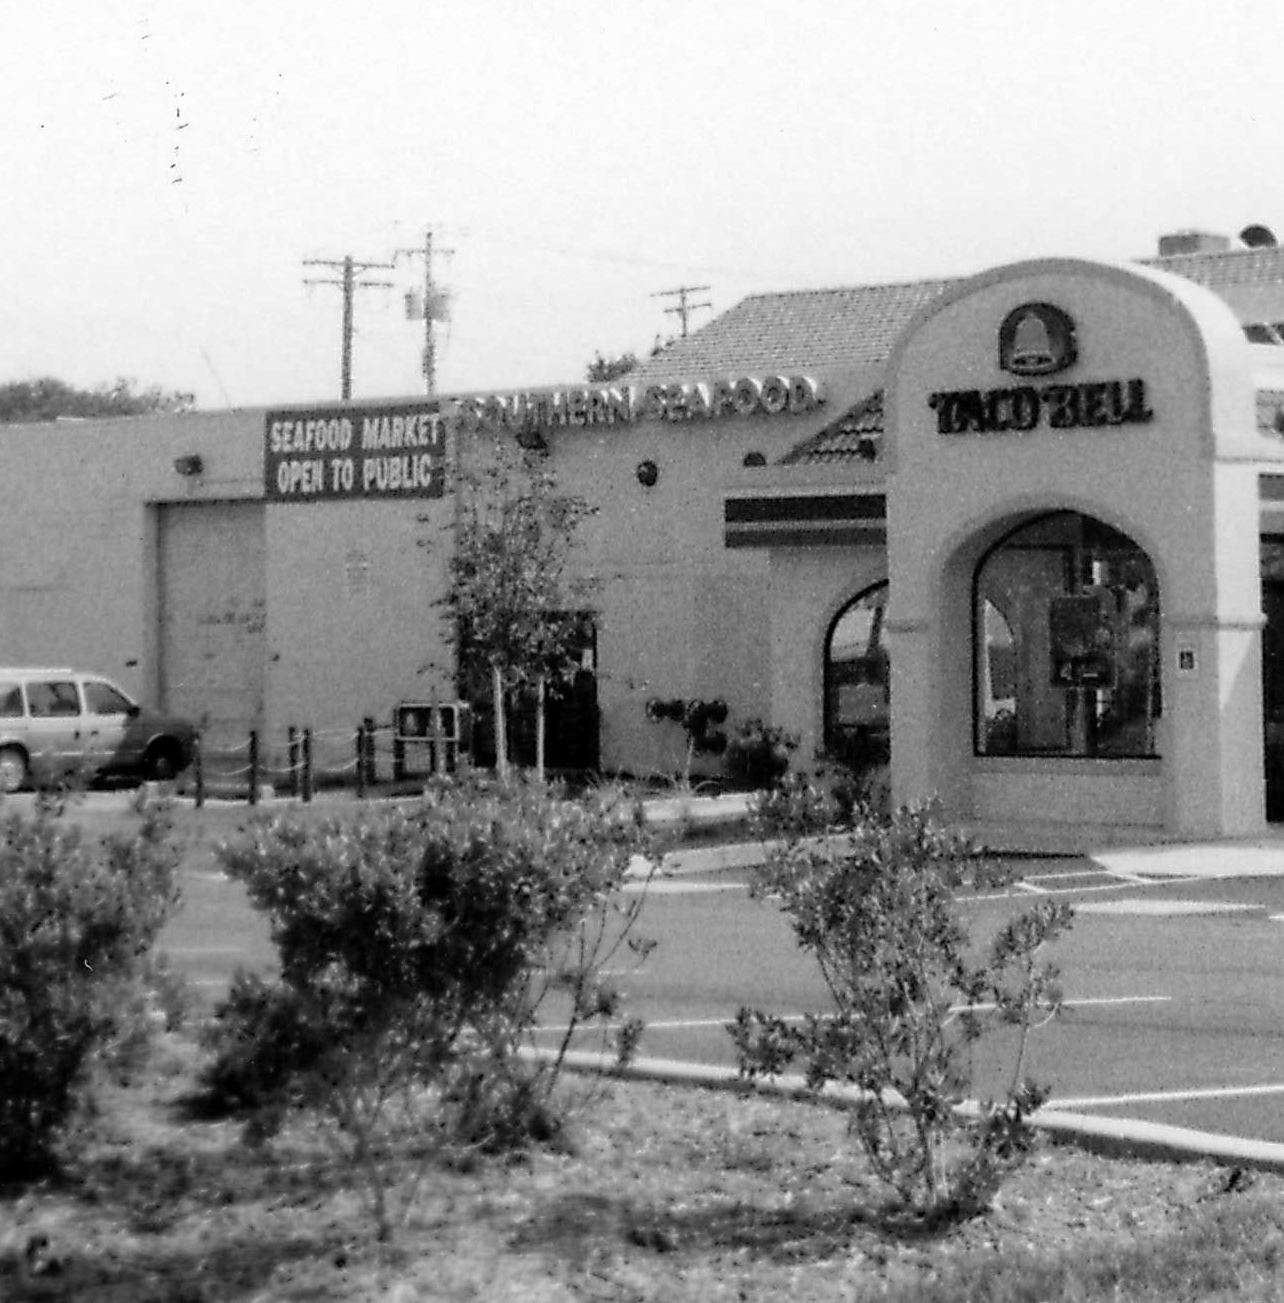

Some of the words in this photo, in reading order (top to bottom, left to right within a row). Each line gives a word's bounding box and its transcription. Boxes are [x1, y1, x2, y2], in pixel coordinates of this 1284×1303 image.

[928, 386, 1040, 435] TACO
[1041, 378, 1154, 429] BELL
[271, 418, 352, 453] SEAFOOD
[362, 412, 440, 450] MARKET
[278, 459, 324, 494] OPEN
[331, 458, 354, 492] TO
[363, 453, 432, 491] PUBLIC
